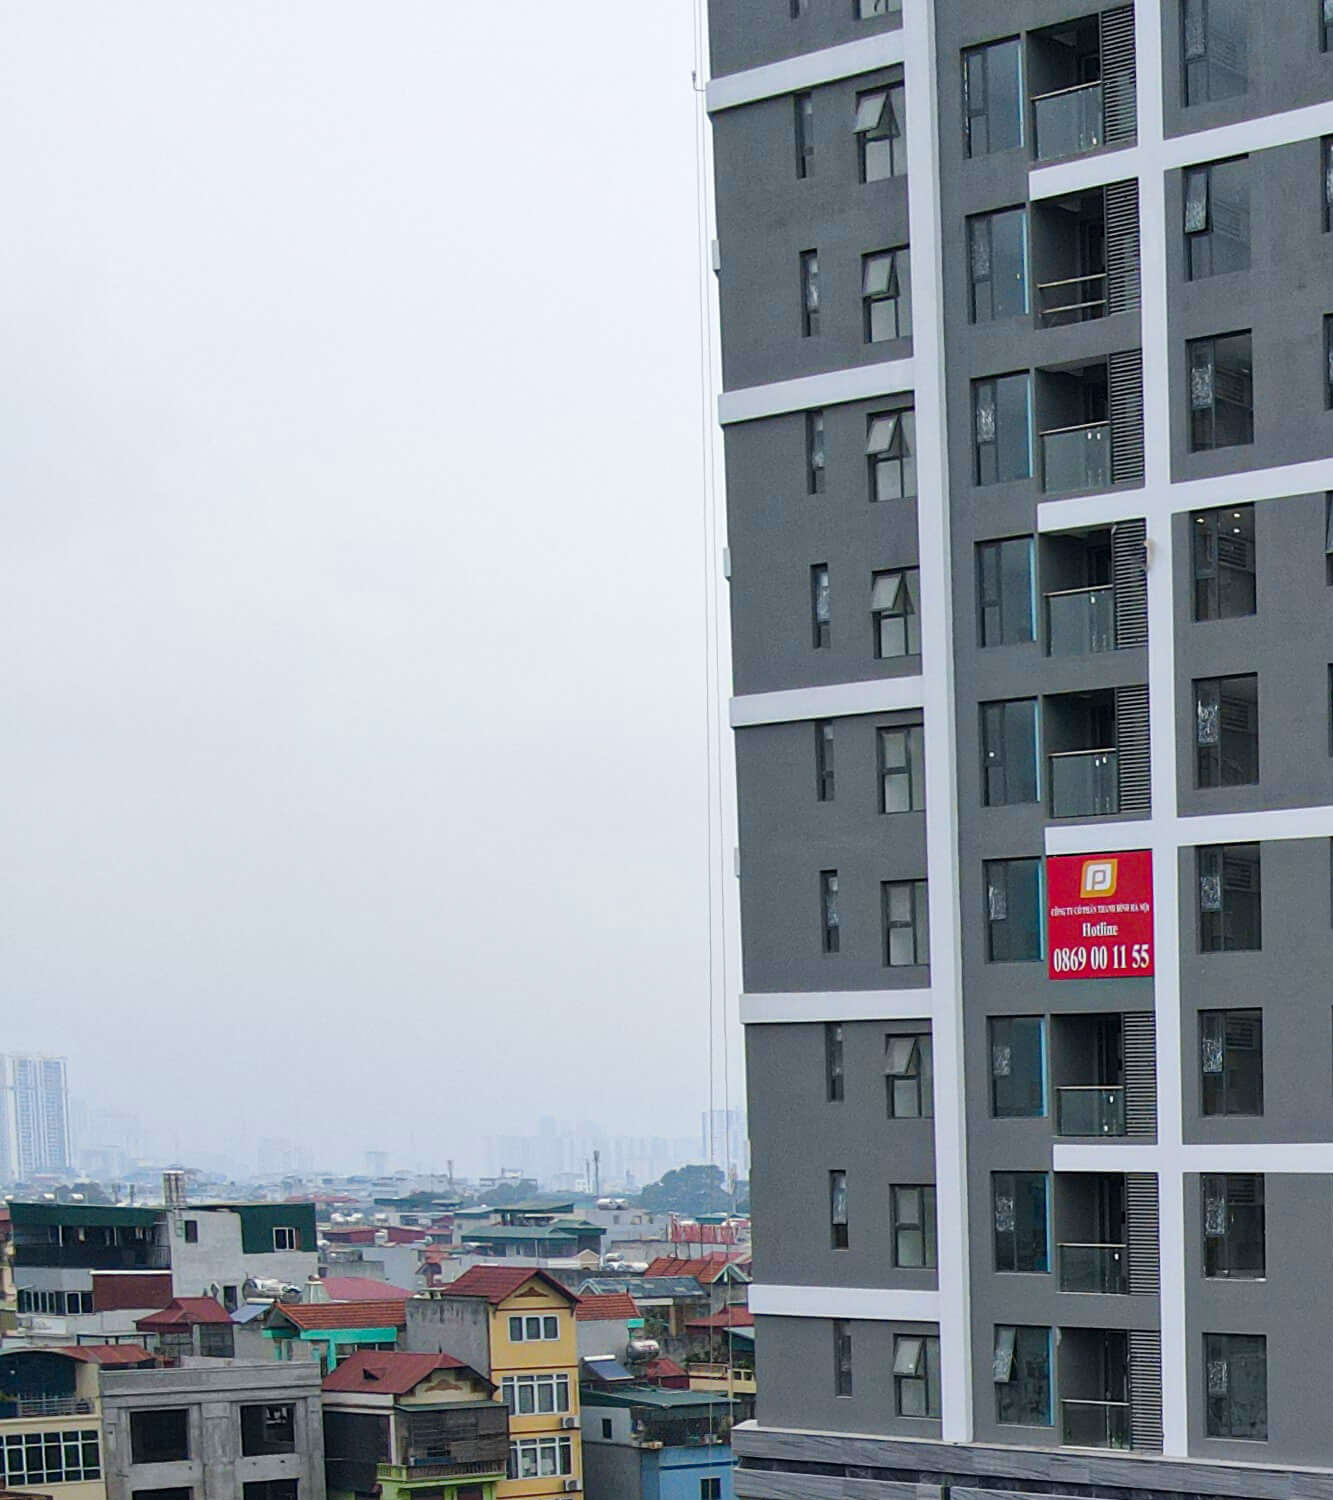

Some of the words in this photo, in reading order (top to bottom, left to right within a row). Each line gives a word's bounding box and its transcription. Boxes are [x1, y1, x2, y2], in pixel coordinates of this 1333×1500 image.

[1082, 921, 1119, 937] Hotline
[1053, 946, 1087, 973] 0869
[1090, 945, 1108, 970] 00
[1112, 944, 1128, 969] 11
[1131, 943, 1150, 969] 55
